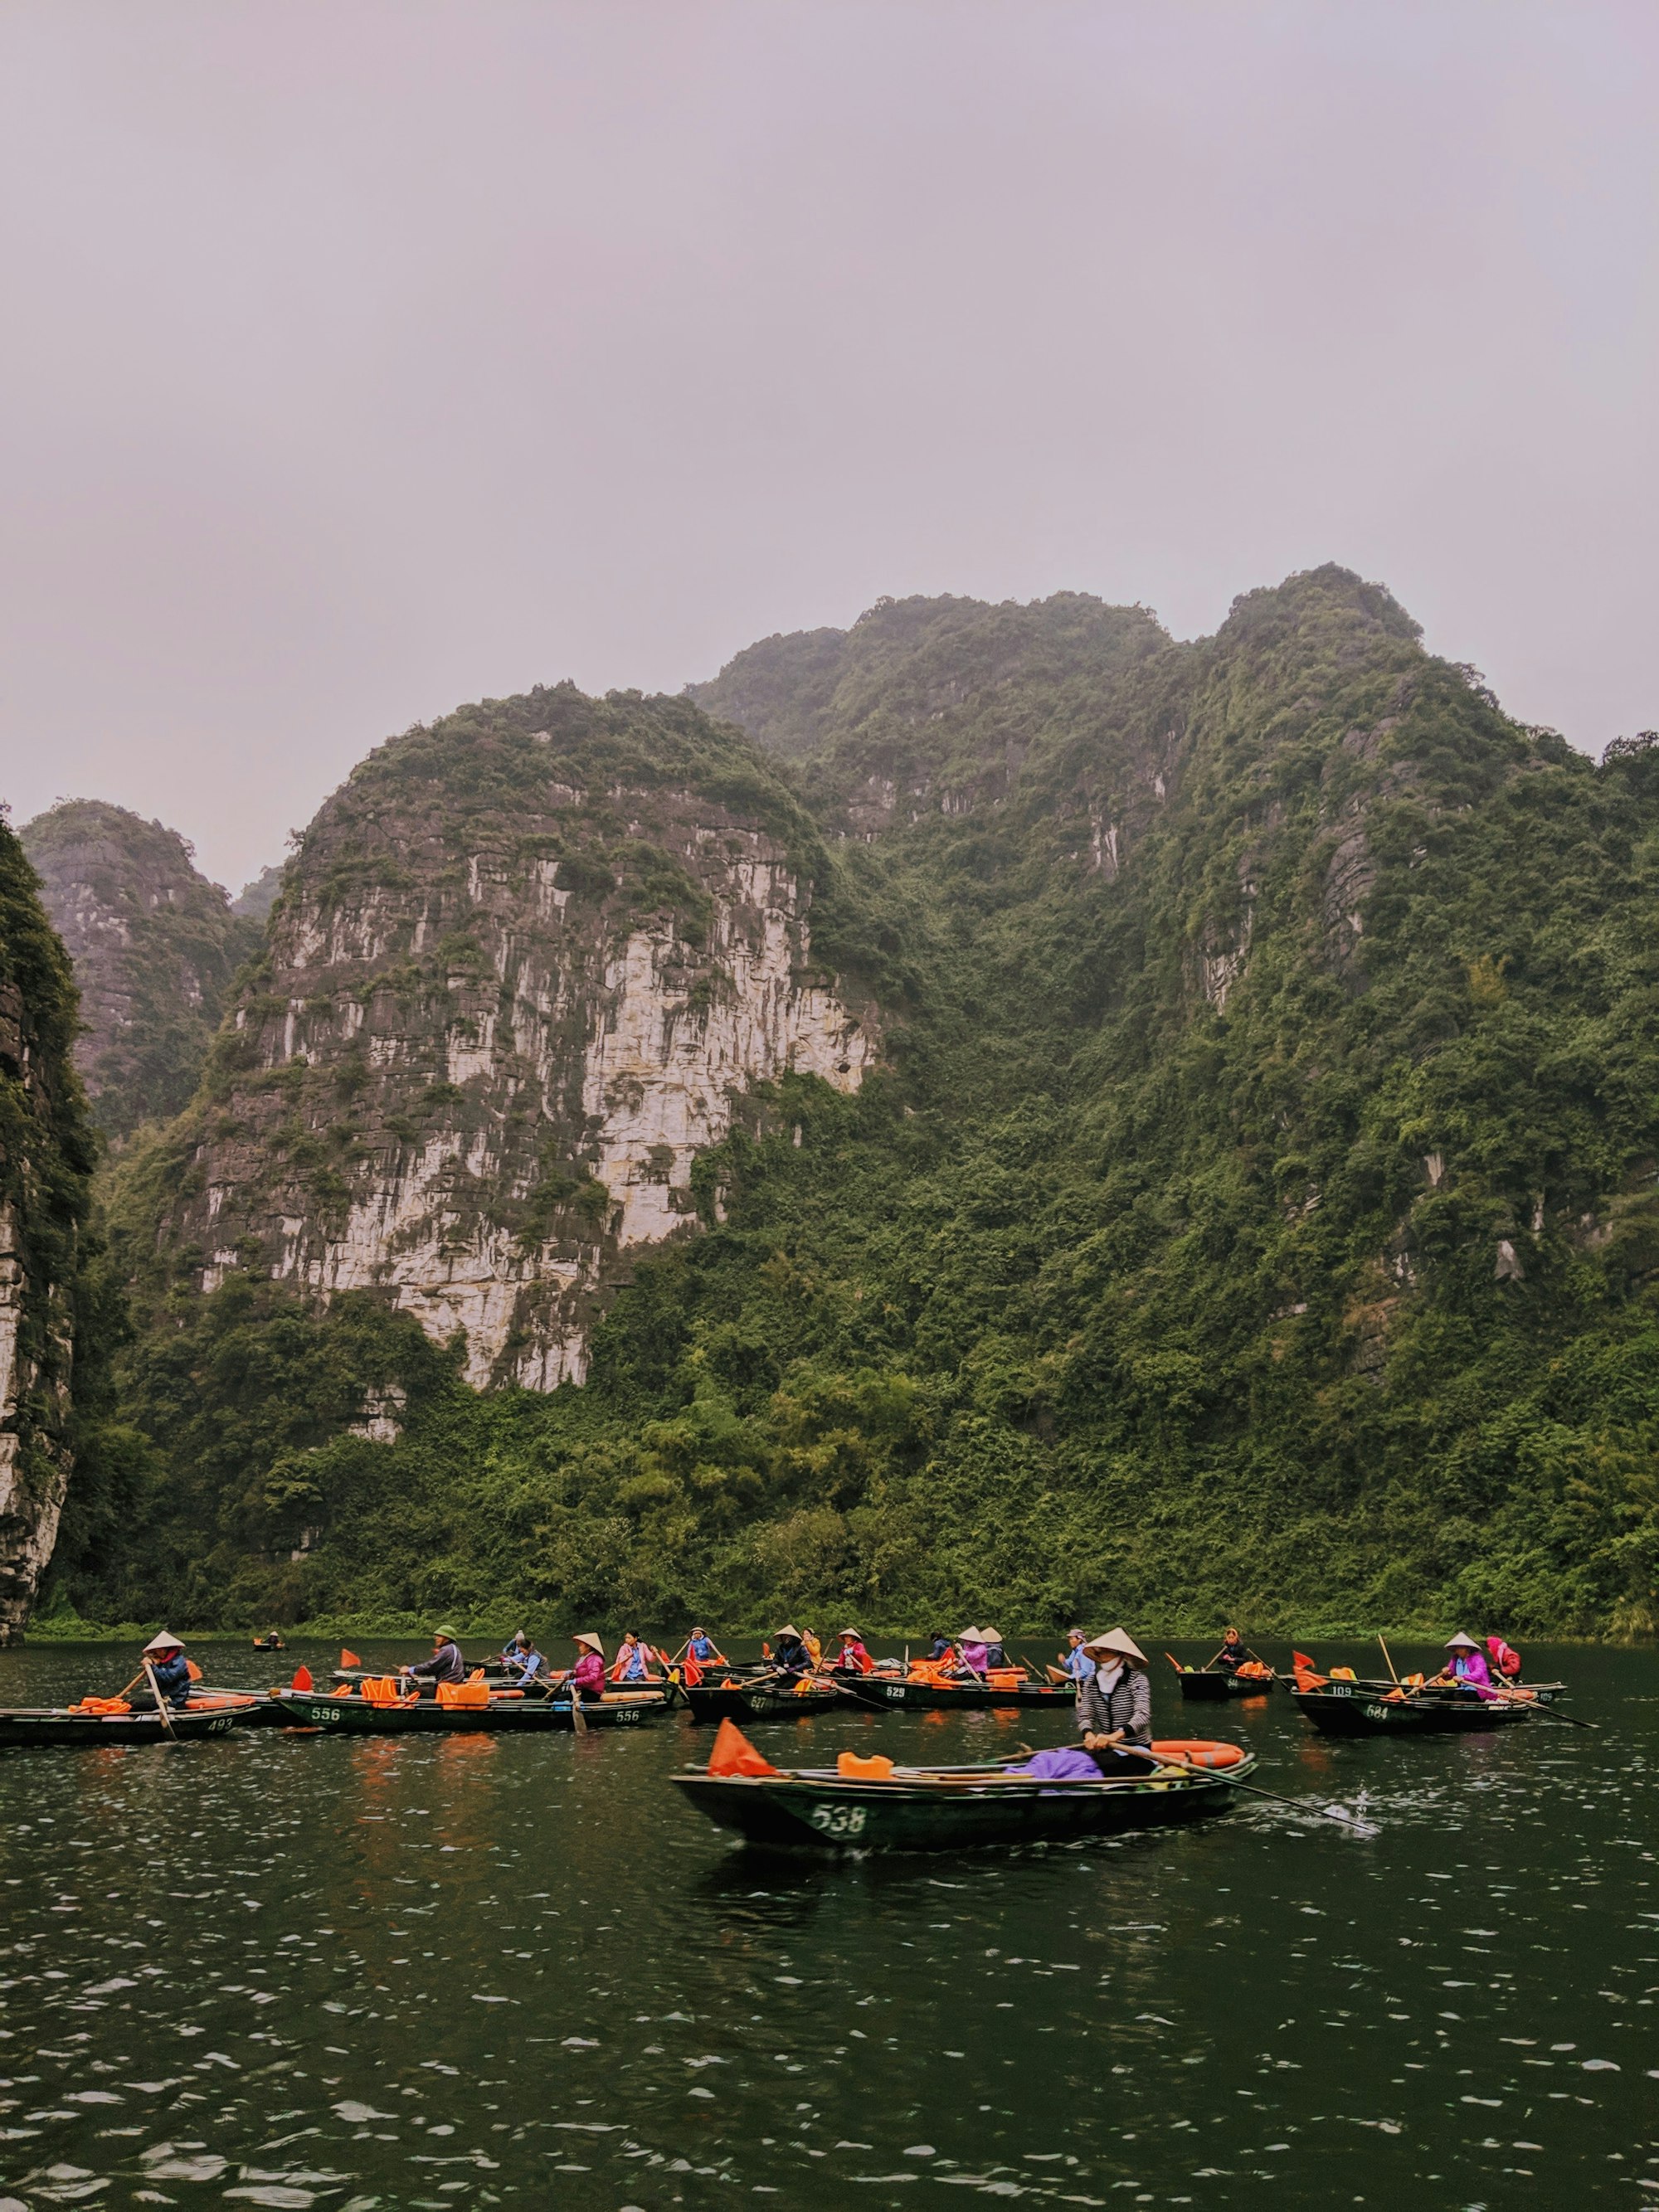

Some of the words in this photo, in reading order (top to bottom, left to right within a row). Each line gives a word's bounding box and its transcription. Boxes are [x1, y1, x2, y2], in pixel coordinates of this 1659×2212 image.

[886, 1685, 905, 1698] 529
[1332, 1685, 1352, 1697] 109
[311, 1707, 341, 1721] 556
[616, 1710, 640, 1723] 556
[207, 1718, 233, 1732] 493
[812, 1803, 868, 1833] 538
